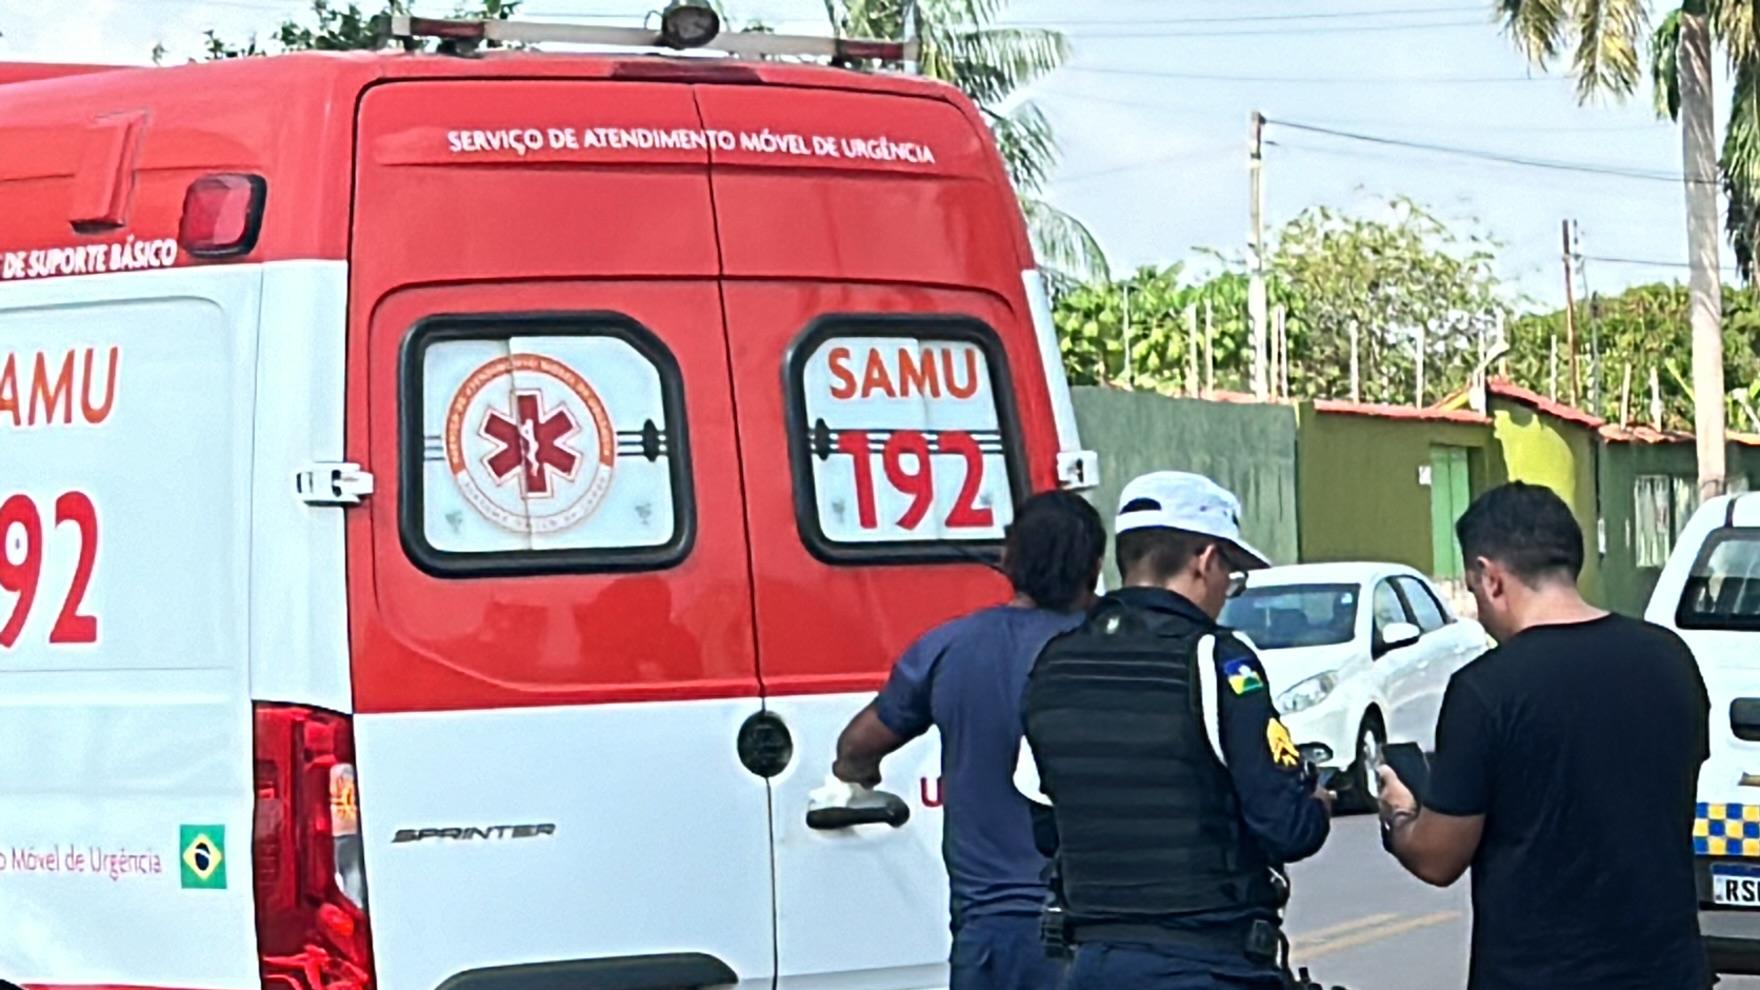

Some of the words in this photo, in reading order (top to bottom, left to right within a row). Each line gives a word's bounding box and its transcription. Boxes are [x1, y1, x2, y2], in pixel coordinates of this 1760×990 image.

[448, 128, 543, 156] SERVIÇO
[548, 128, 579, 149] DE
[584, 128, 735, 150] ATENDIMENTO
[740, 128, 811, 155] MÓVEL
[813, 136, 839, 157] DE
[841, 136, 935, 164] URGÊNCIA
[3, 251, 26, 279] DE
[28, 244, 108, 277] SUPORTE
[109, 234, 178, 270] BÁSICO
[828, 347, 977, 399] SAMU
[837, 430, 994, 530] 192
[391, 823, 556, 843] SPRINTER
[12, 844, 59, 871] Móvel
[65, 844, 85, 872] de
[90, 846, 162, 881] Urgência
